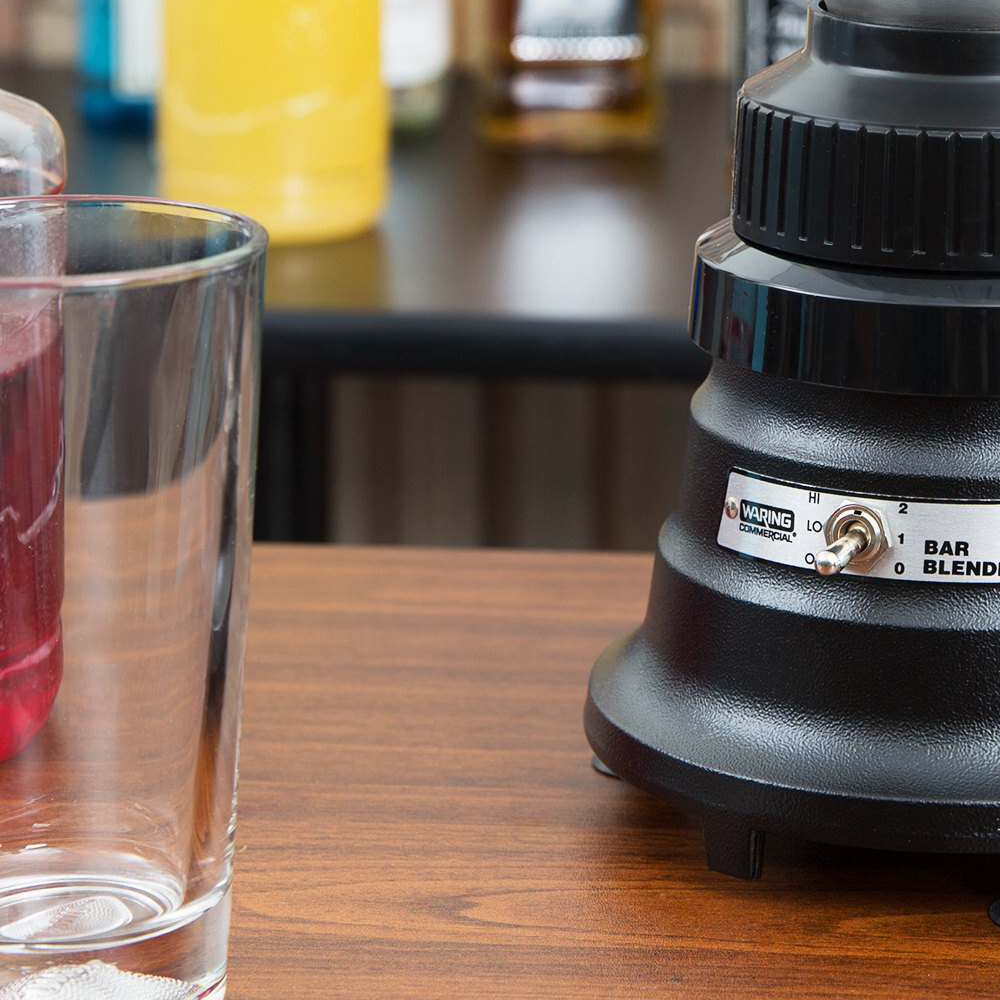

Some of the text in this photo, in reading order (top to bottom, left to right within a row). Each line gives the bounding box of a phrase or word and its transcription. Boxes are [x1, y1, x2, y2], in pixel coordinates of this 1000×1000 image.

[808, 491, 821, 505] HI
[898, 502, 908, 515] 2
[741, 502, 793, 530] WARING
[806, 519, 823, 533] LO
[897, 533, 905, 544] 1
[924, 540, 969, 557] BAR
[894, 561, 905, 575] 0
